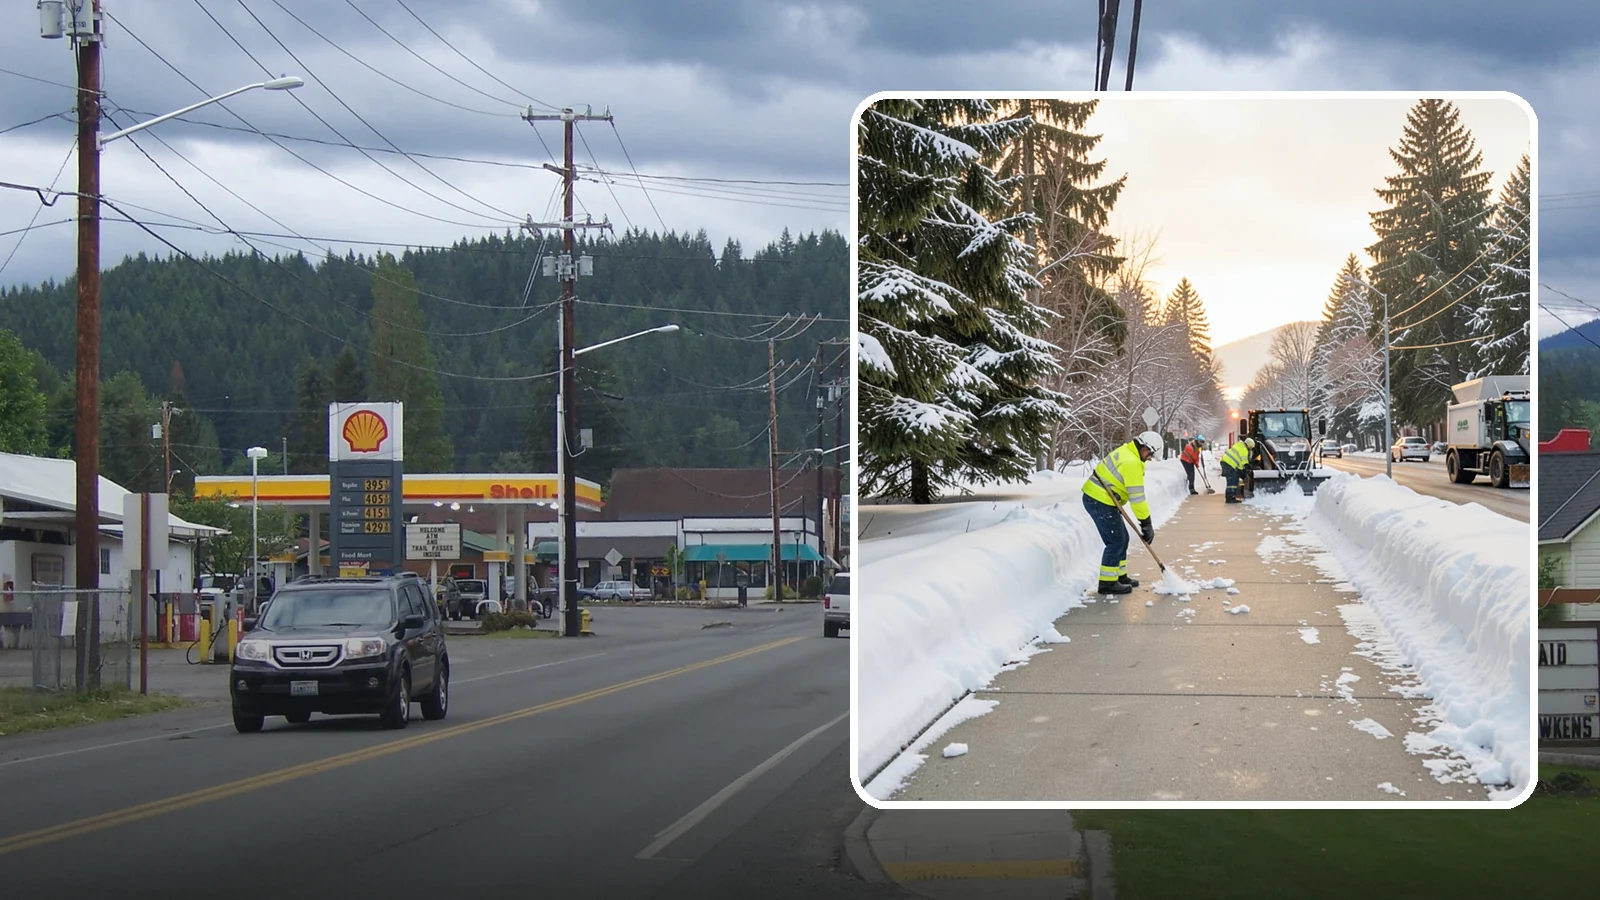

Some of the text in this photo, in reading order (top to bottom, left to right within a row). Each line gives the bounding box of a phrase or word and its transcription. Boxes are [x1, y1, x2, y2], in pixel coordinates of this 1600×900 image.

[365, 480, 384, 490] 395
[490, 484, 548, 499] Shell
[365, 494, 384, 504] 405
[365, 508, 384, 518] 415
[365, 522, 384, 532] 429
